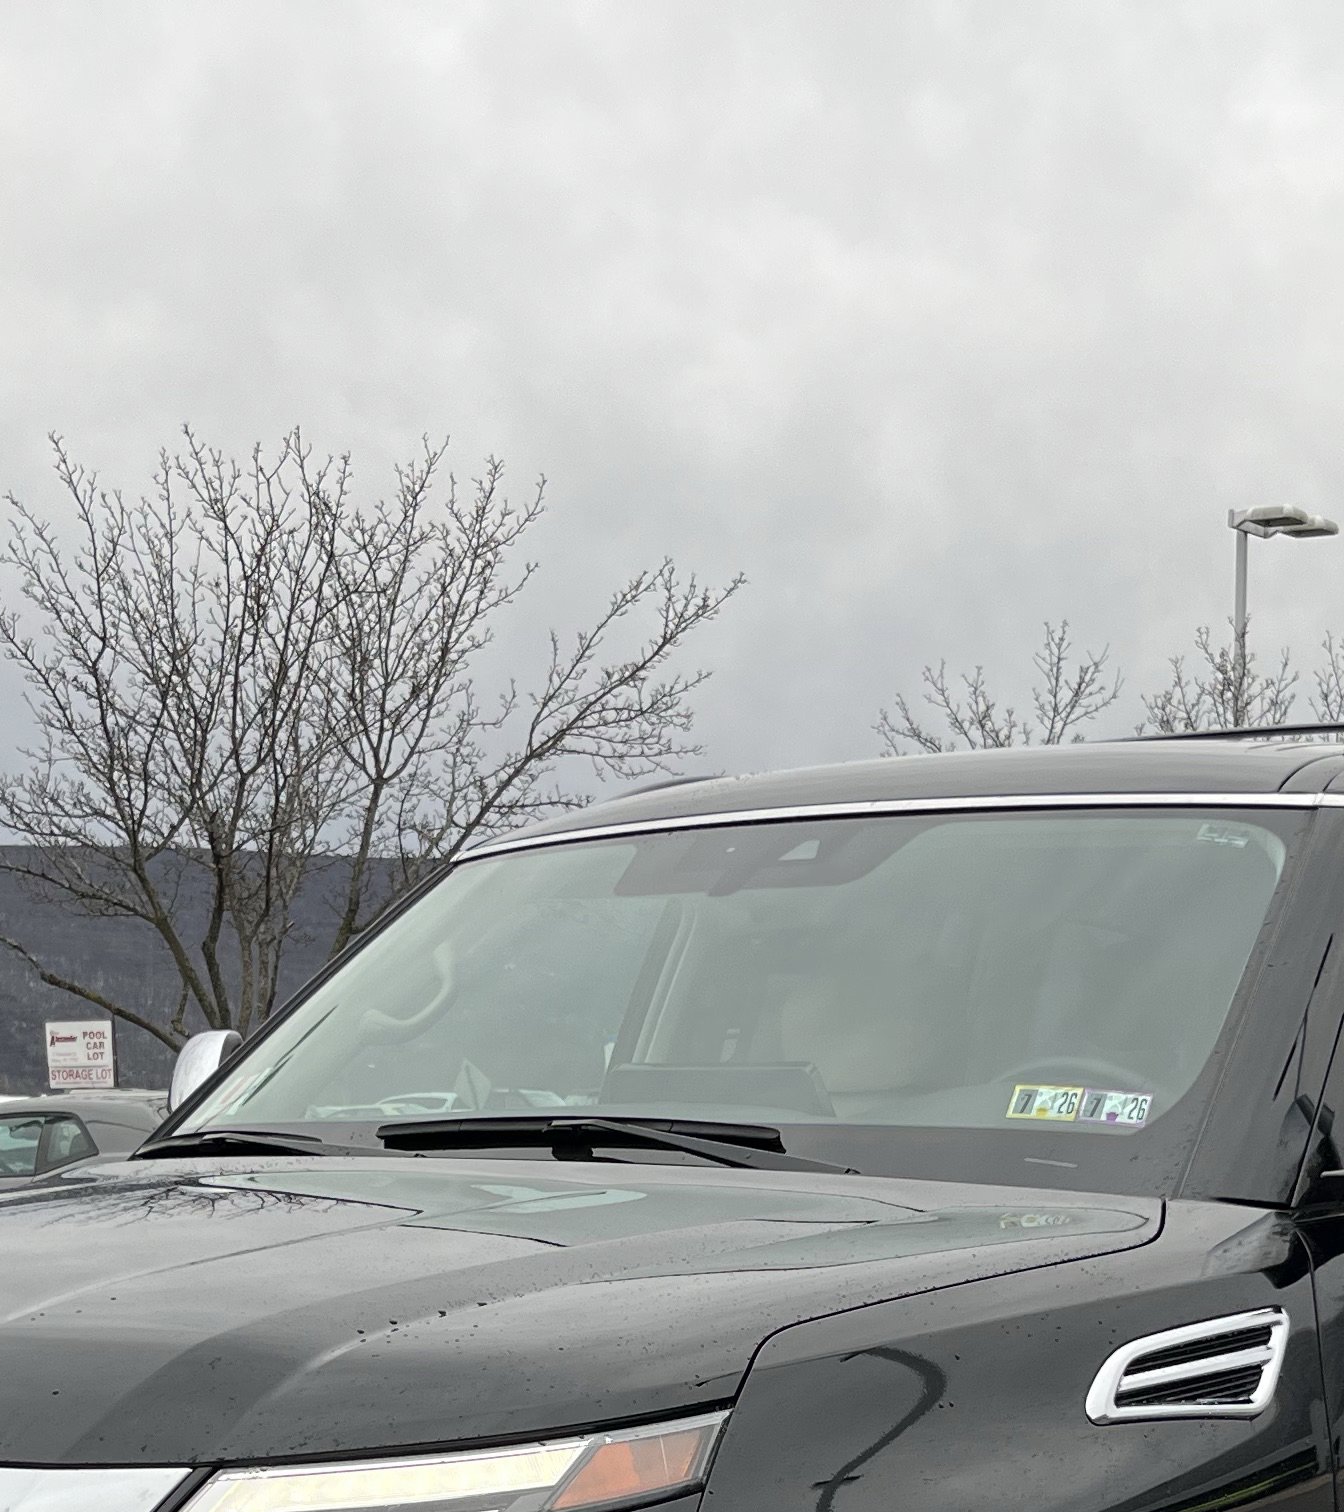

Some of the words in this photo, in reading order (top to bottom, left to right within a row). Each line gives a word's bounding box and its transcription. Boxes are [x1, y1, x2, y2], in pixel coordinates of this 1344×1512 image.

[82, 1031, 108, 1040] POOL
[86, 1041, 105, 1050] CAR
[87, 1051, 105, 1061] LOT
[50, 1068, 94, 1081] STORAGE
[95, 1068, 112, 1080] LOT
[1019, 1093, 1029, 1114] 7
[1057, 1092, 1078, 1114] 26
[1087, 1097, 1101, 1118] 7
[1127, 1097, 1148, 1120] 26
